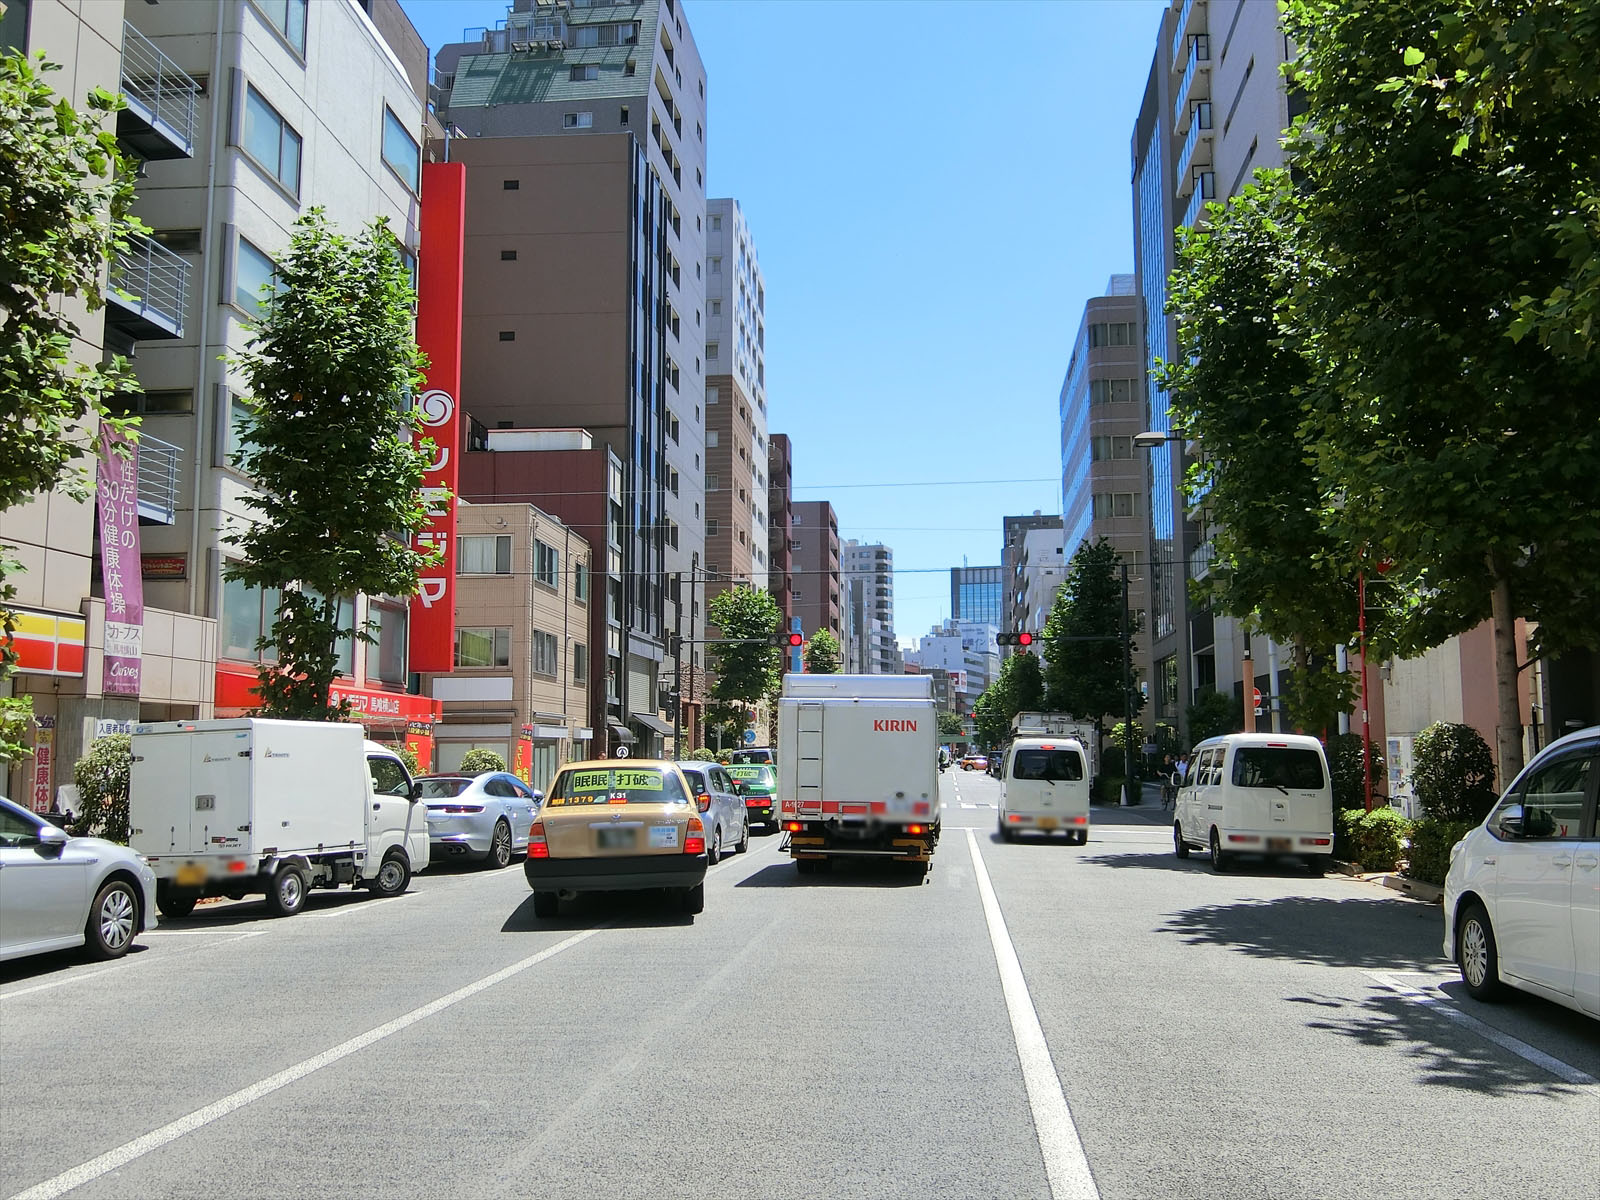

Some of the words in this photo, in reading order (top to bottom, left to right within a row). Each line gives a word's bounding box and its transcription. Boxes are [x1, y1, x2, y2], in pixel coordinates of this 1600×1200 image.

[120, 441, 135, 549] 性だけの
[101, 478, 126, 614] 30分健康体操
[99, 723, 132, 735] 入居者募集
[874, 719, 917, 732] KIRIN
[568, 796, 594, 804] 1379
